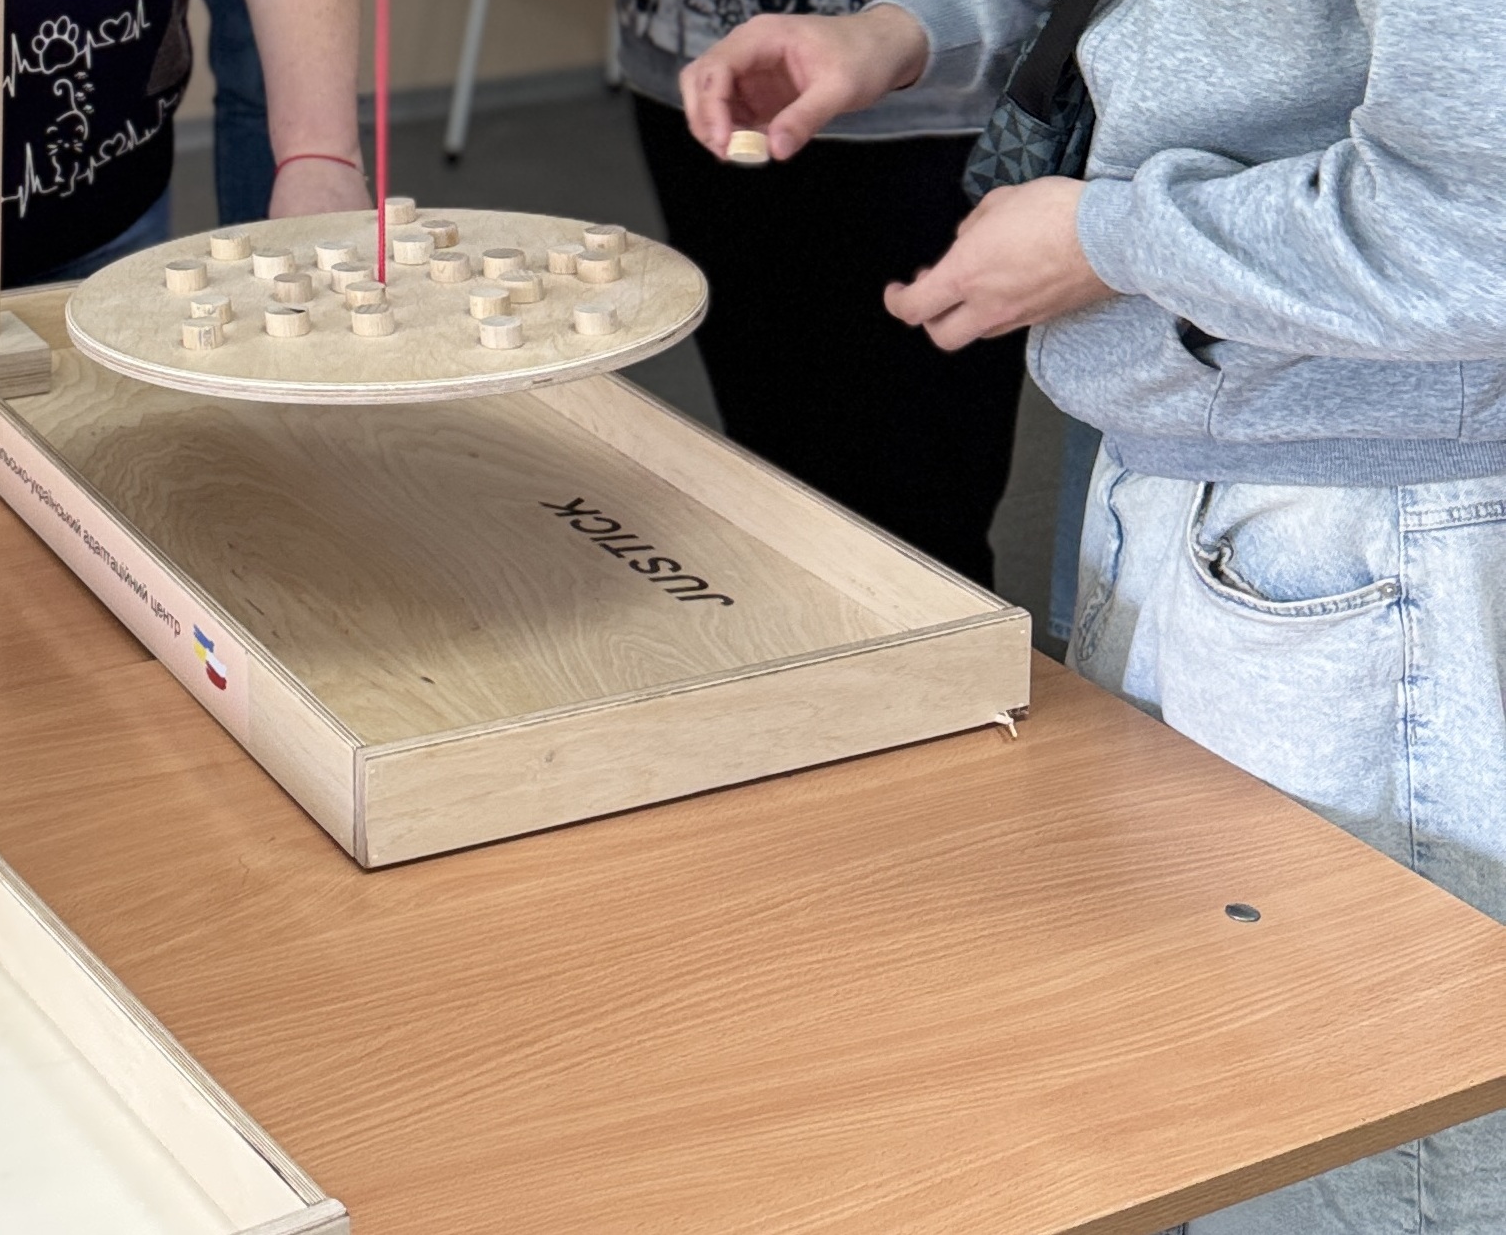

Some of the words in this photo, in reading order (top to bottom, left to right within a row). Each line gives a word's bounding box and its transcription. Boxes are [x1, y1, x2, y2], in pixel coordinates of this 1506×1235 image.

[83, 529, 149, 604] адаптаційний
[150, 594, 182, 638] центр
[537, 496, 735, 607] JUSTICK
